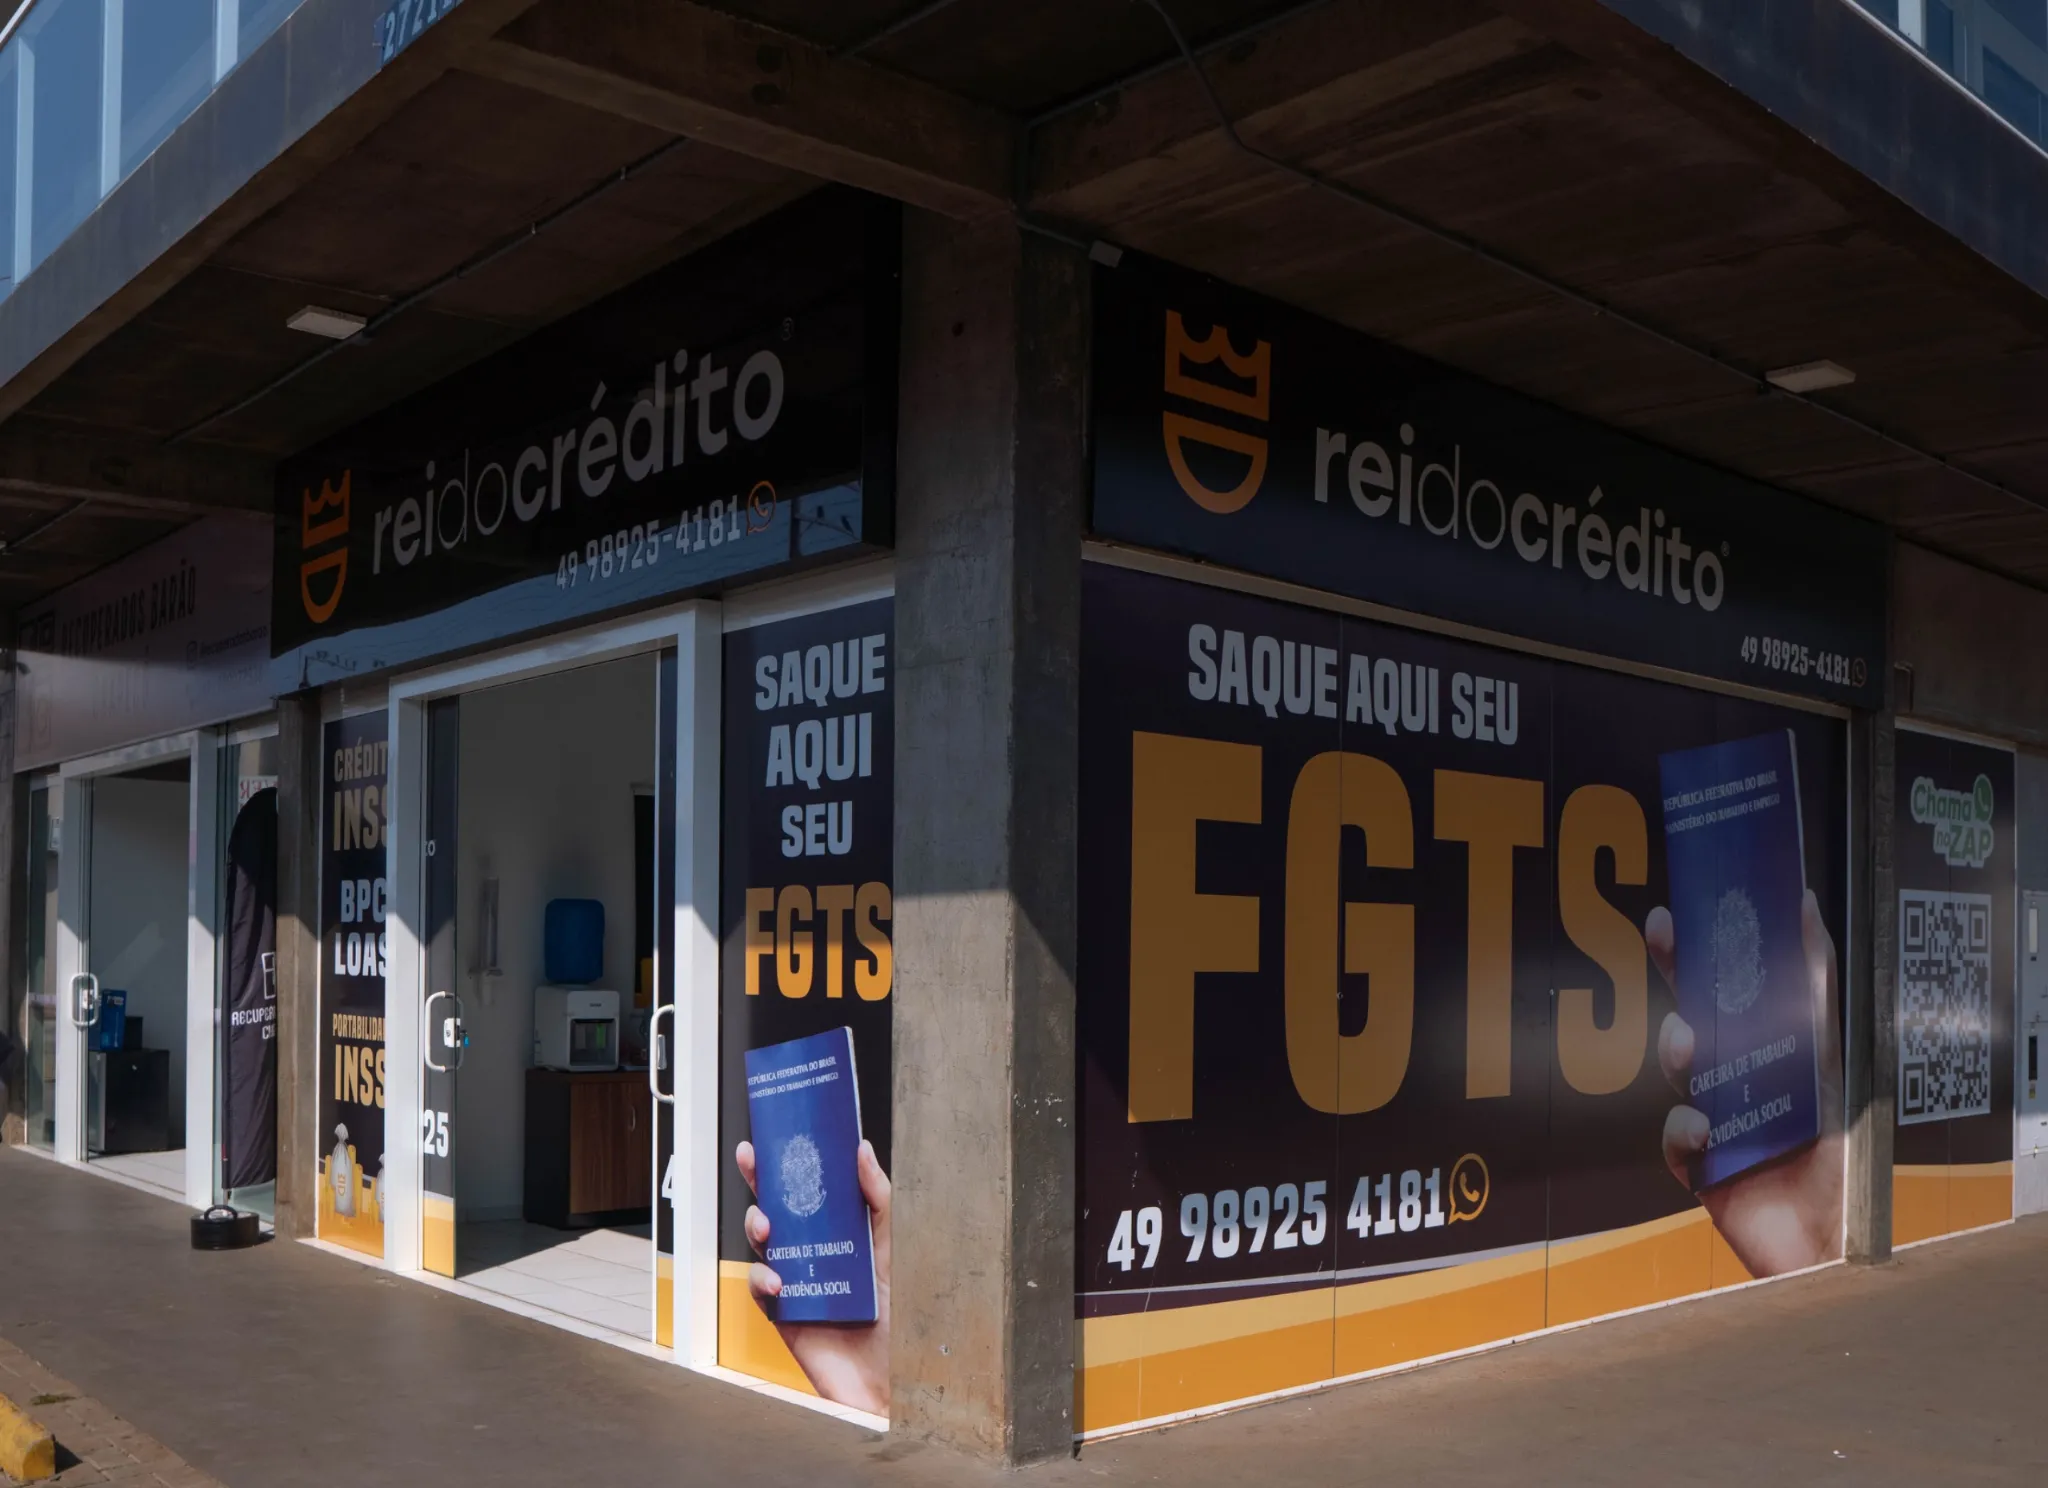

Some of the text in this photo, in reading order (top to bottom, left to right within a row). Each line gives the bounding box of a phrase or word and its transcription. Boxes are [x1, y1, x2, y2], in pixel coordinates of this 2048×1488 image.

[556, 494, 740, 590] 49 98925-4181
[755, 633, 886, 711] SAQUE
[1188, 623, 1519, 746] SAQUE AQUI SEU
[1741, 635, 1850, 686] 49 98925-4181
[765, 712, 873, 790] AQUI
[1912, 782, 1973, 822] Chama
[781, 801, 853, 858] SEU
[1937, 824, 1991, 861] no ZAP
[340, 877, 386, 923] BPC
[745, 881, 893, 1001] FGTS
[1127, 730, 1649, 1123] FGTS
[1736, 1055, 1750, 1077] DE
[1750, 1034, 1796, 1070] TRABALHO
[1743, 1084, 1750, 1103] E
[1761, 1093, 1792, 1124] SOCIAL
[1107, 1167, 1445, 1272] 49 98925 4181
[766, 1240, 854, 1261] CARTEIRA DE TRABALHO
[809, 1263, 815, 1277] E
[823, 1281, 852, 1296] SOCIAL
